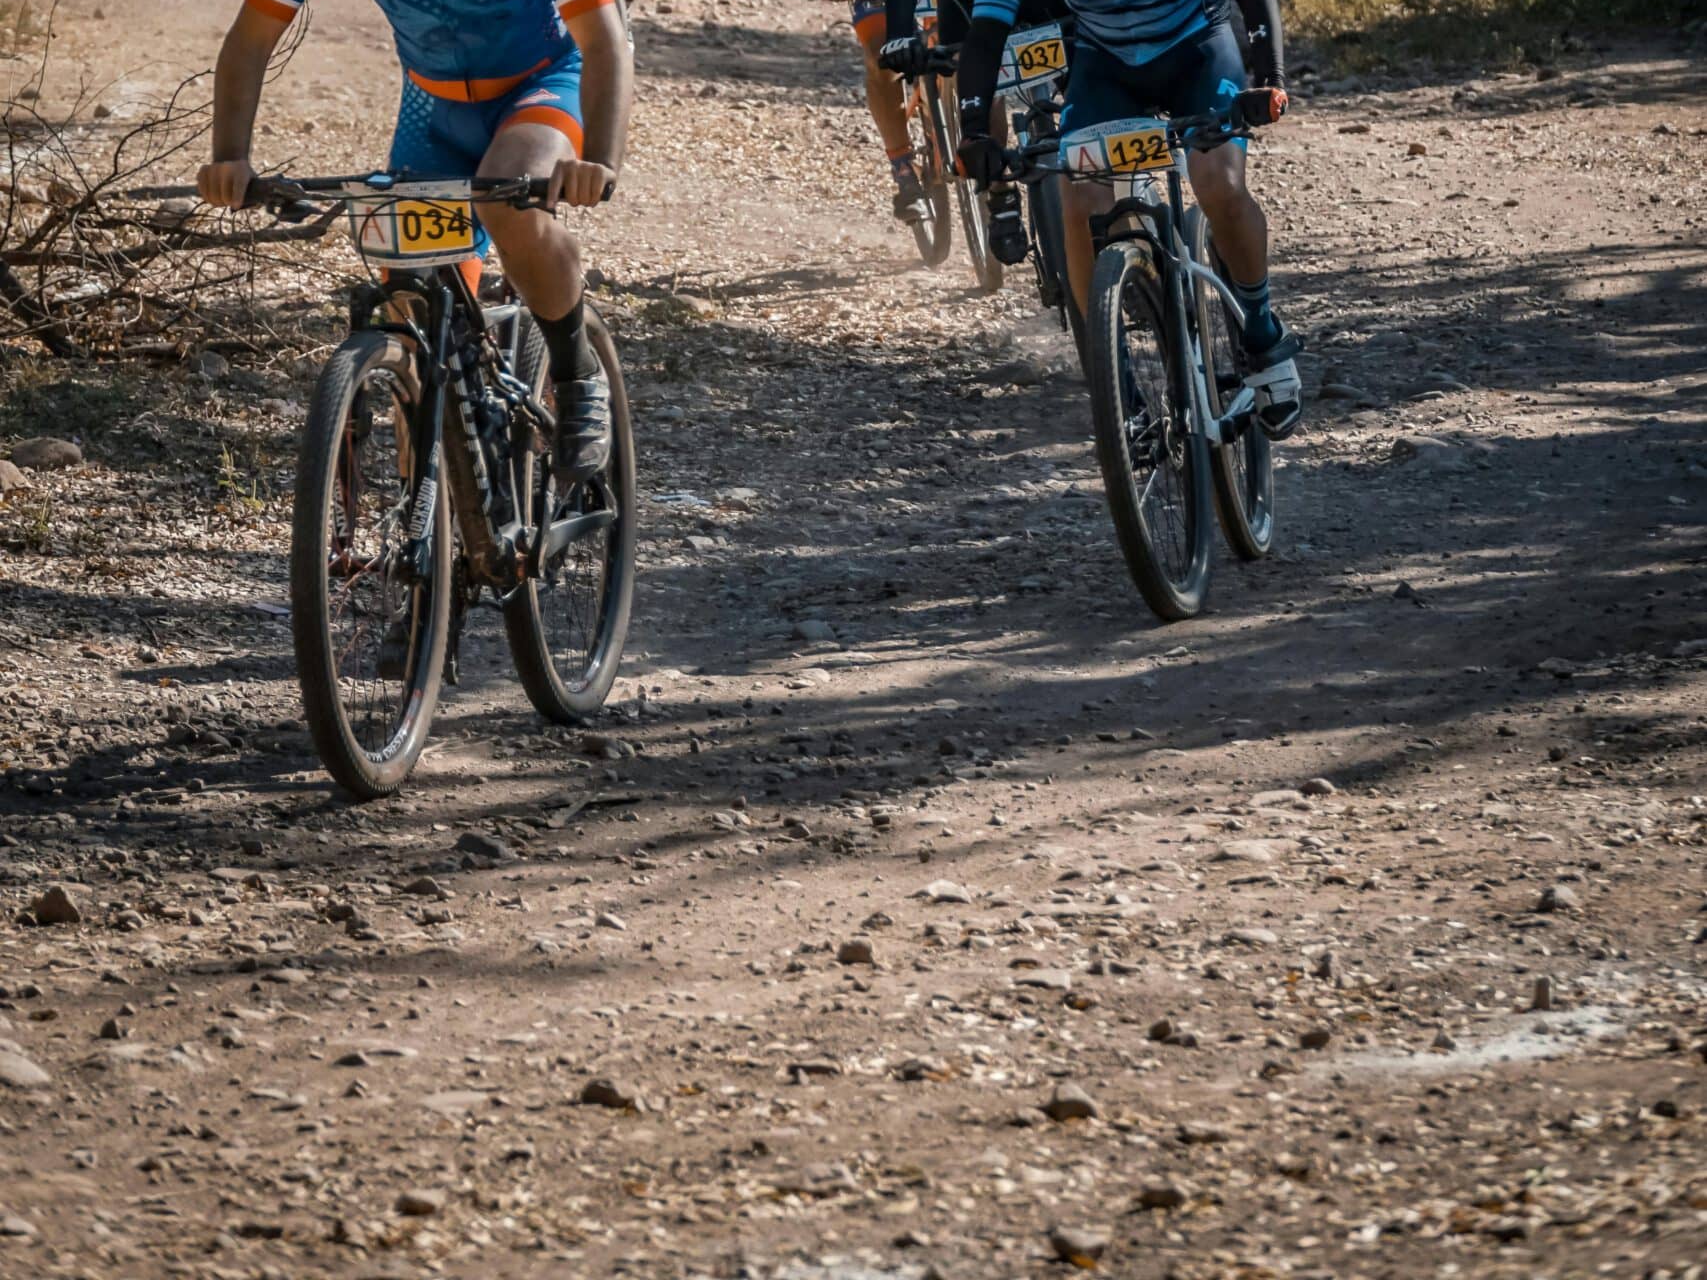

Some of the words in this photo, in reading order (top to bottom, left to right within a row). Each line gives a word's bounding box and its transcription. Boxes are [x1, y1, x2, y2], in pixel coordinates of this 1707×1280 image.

[1019, 42, 1060, 71] 037
[1078, 146, 1099, 172] A
[1113, 134, 1168, 166] 132
[363, 206, 386, 245] A
[402, 206, 469, 242] 034
